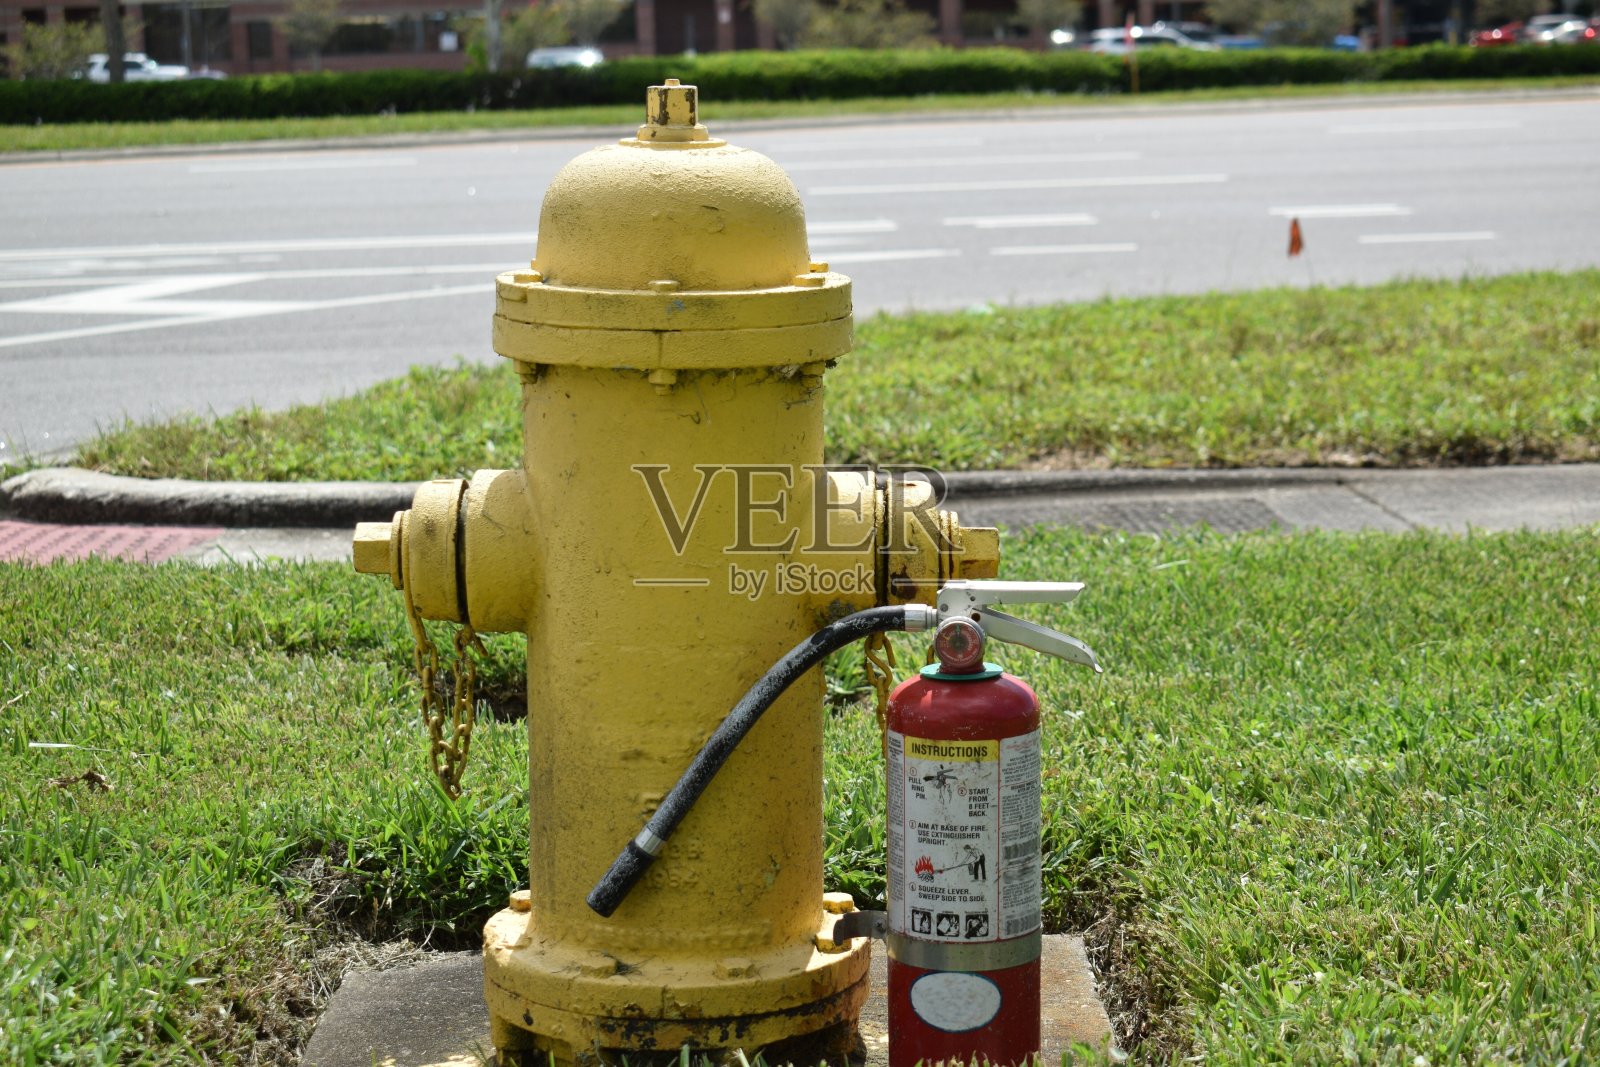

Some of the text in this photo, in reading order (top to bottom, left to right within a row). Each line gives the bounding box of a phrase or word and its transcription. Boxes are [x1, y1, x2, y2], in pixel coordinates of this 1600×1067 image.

[911, 742, 988, 757] INSTRUCTIONS
[908, 776, 922, 784] PULL
[911, 784, 924, 792] RING
[968, 787, 989, 795] START
[974, 802, 989, 810] FEET
[930, 823, 939, 831] AT
[940, 824, 958, 832] BASE
[917, 829, 981, 840] USE EXTINGUISHER
[918, 884, 946, 894] SQUEEZE
[918, 892, 940, 901] SWEEP
